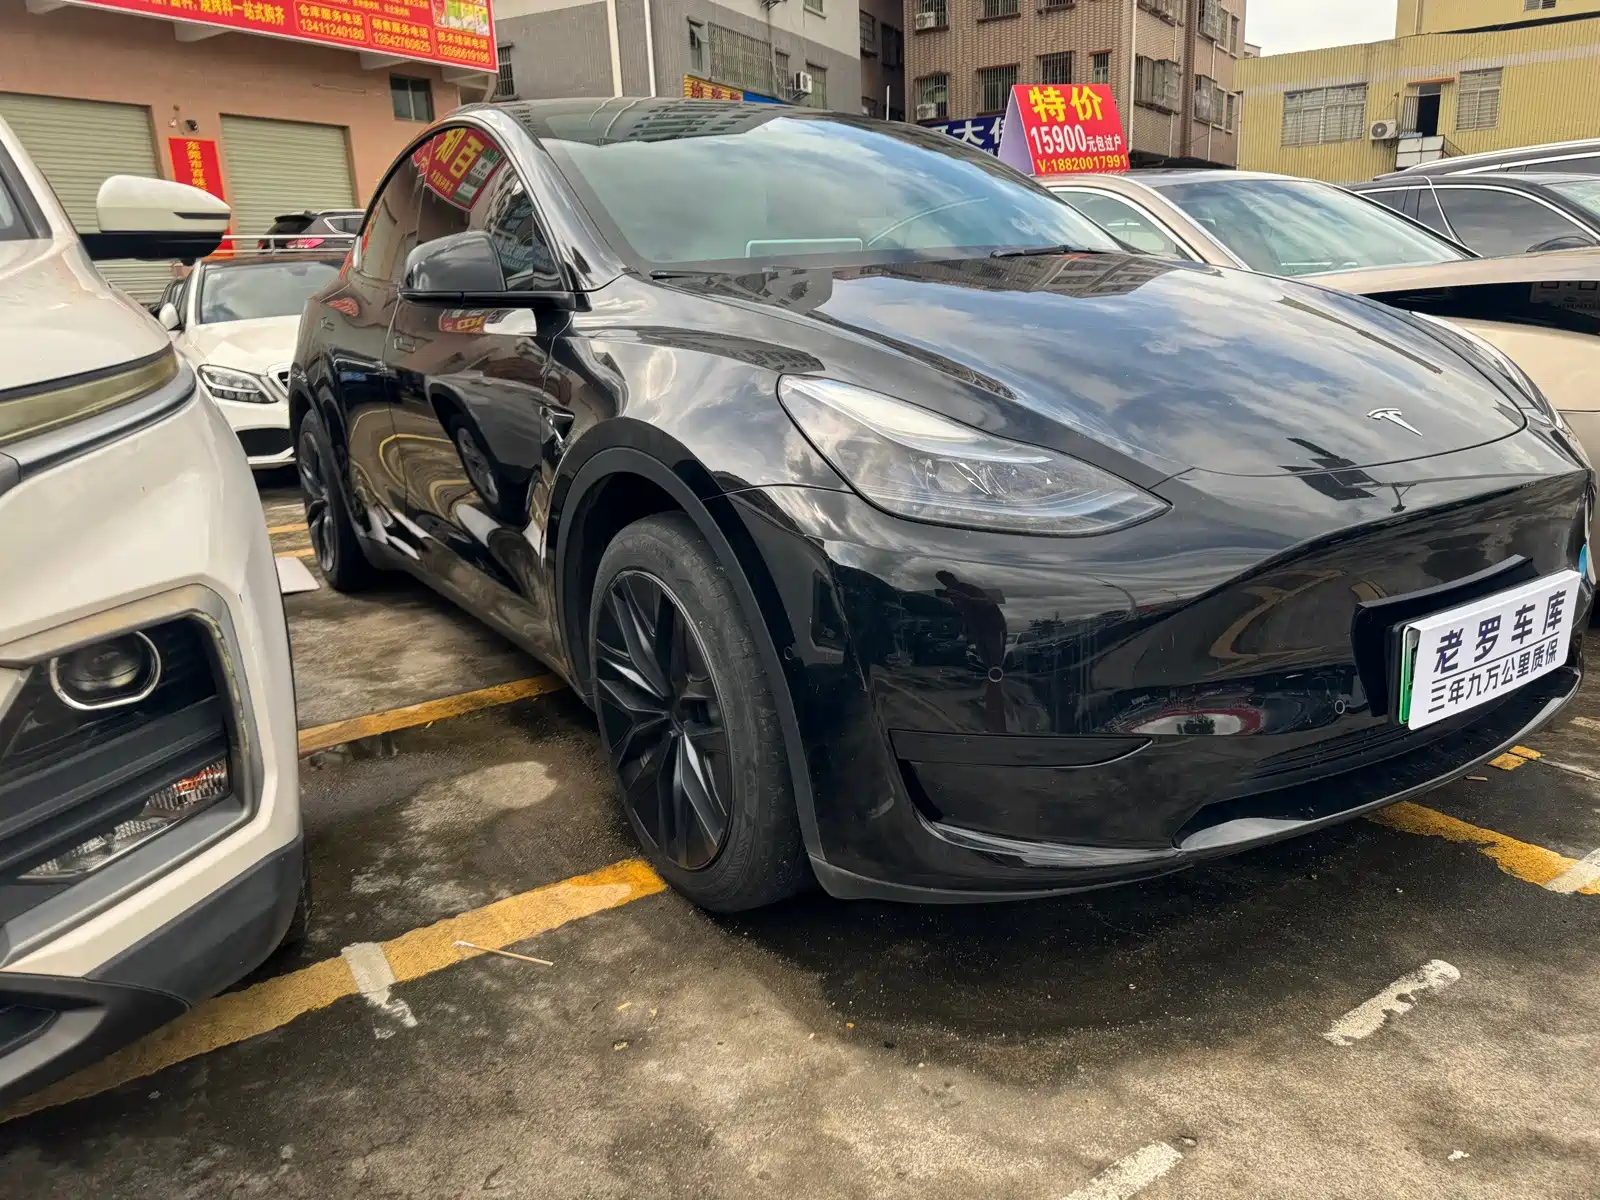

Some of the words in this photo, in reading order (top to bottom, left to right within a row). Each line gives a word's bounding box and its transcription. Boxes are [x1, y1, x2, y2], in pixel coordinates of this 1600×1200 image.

[299, 4, 363, 26] 仓库服务电话
[1028, 85, 1103, 123] 特价
[1030, 123, 1122, 155] 15900元包过户
[1036, 154, 1128, 173] V:18820017991
[1432, 590, 1567, 675] 老罗车库
[1427, 638, 1559, 714] 三年九万公里质保
